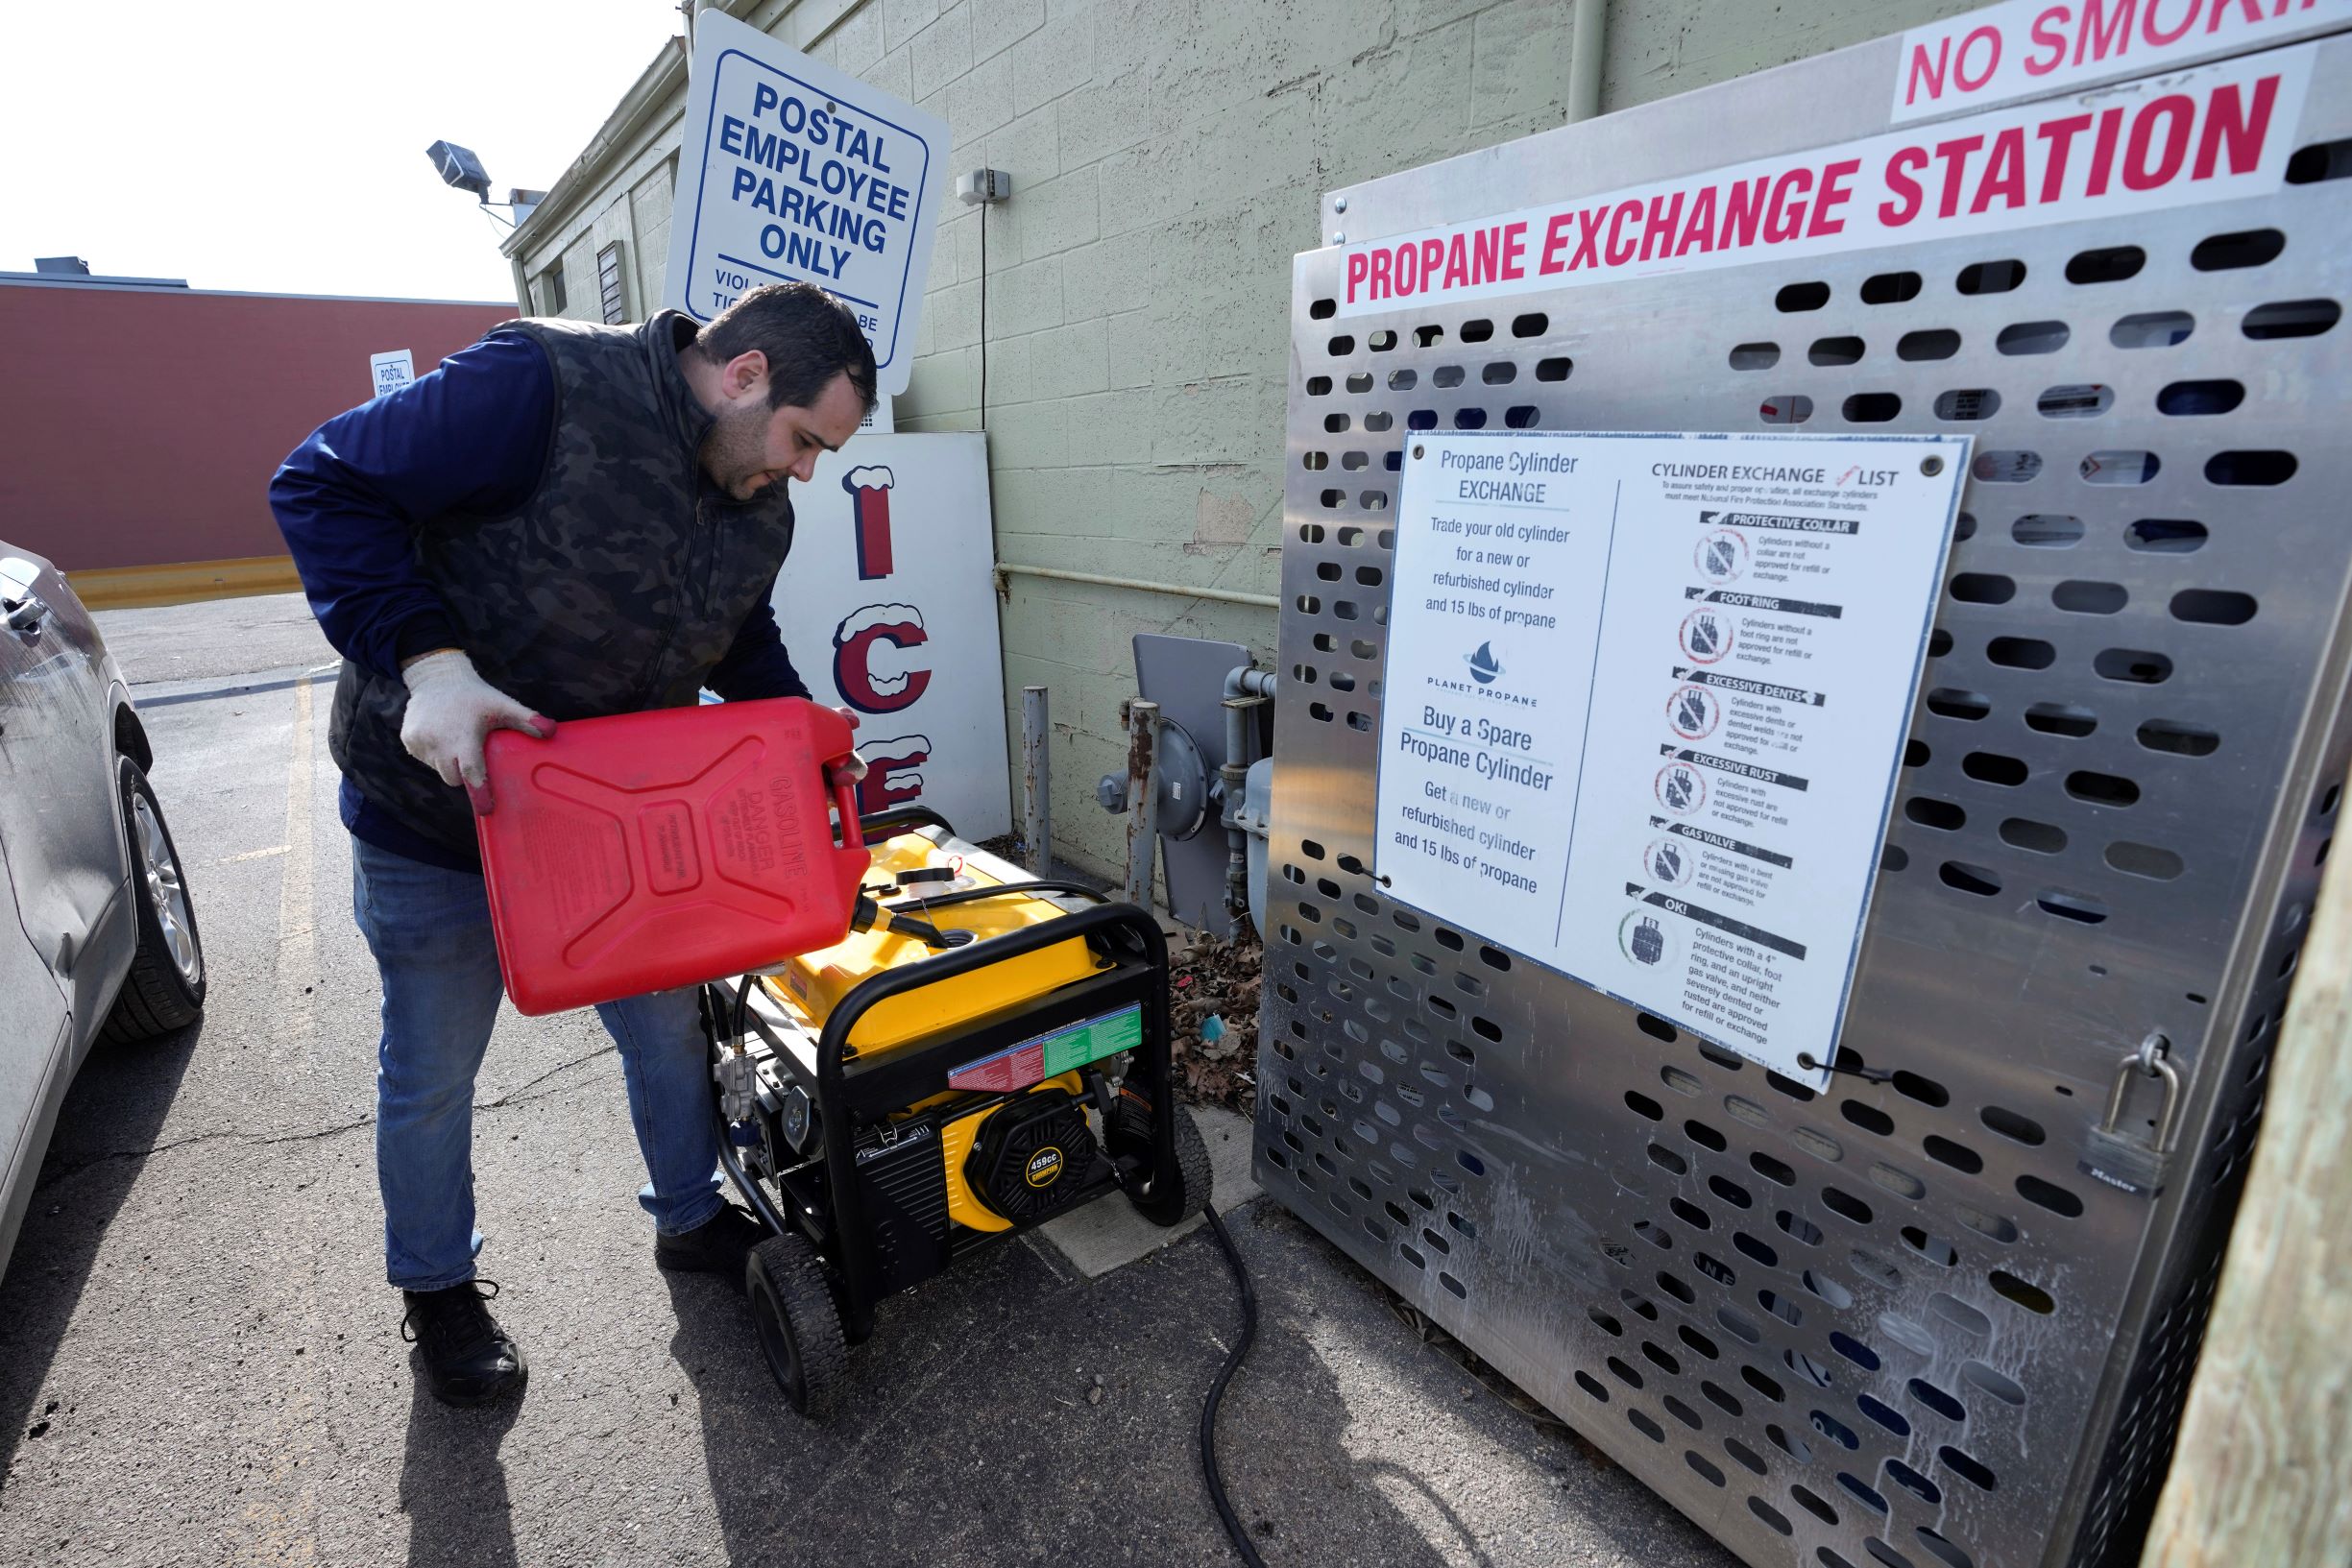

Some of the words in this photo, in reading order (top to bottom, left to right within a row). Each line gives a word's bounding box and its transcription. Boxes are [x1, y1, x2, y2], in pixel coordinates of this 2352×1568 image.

[1905, 26, 2002, 106] NO
[753, 83, 890, 174] POSTAL
[720, 114, 909, 221] EMPLOYEE
[1346, 222, 1527, 304] PROPANE
[1539, 157, 1861, 276] EXCHANGE
[1878, 74, 2281, 228] STATION
[732, 167, 886, 253] PARKING
[761, 224, 852, 279] ONLY
[859, 315, 878, 331] BE
[381, 368, 404, 381] POSTAL
[1442, 450, 1503, 472] Propane
[1510, 451, 1578, 475] Cylinder
[1652, 463, 1727, 479] CYLINDER
[1733, 466, 1825, 483] EXCHANGE
[1858, 470, 1900, 486] LIST
[1460, 480, 1546, 503] EXCHANGE
[1432, 517, 1462, 533] Trade
[1466, 523, 1492, 537] your
[1495, 522, 1514, 538] old
[1518, 525, 1570, 543] cylinder
[1733, 514, 1802, 529] PROTECTIVE
[1803, 518, 1851, 533] COLLAR
[1758, 536, 1792, 548] Cylinders
[1795, 538, 1823, 549] without
[1457, 546, 1472, 561] for
[1476, 551, 1483, 563] a
[1488, 552, 1513, 566] new
[1517, 556, 1530, 567] or
[1755, 560, 1788, 571] approved
[1433, 571, 1499, 592] refurbished
[1504, 581, 1554, 599] cylinder
[1426, 597, 1446, 612] and
[1452, 600, 1465, 614] 15
[1468, 602, 1486, 617] lbs
[1490, 606, 1501, 620] of
[1504, 609, 1556, 628] propane
[1720, 592, 1751, 606] FOOT
[1752, 595, 1780, 609] RING
[1740, 629, 1755, 639] foot
[1756, 632, 1770, 643] ring
[1785, 637, 1798, 645] not
[1742, 617, 1775, 631] Cylinders
[1777, 622, 1806, 635] without
[1737, 640, 1772, 654] approved
[1785, 648, 1803, 658] refill
[1428, 677, 1472, 693] PLANET
[1478, 688, 1537, 708] PROPANE
[1706, 674, 1763, 695] EXCESSIVE
[1764, 685, 1803, 702] DENTS
[1730, 708, 1764, 722] excessive
[1766, 715, 1785, 727] dents
[1732, 696, 1764, 712] Cylinders
[1766, 703, 1782, 713] with
[1423, 705, 1456, 736] Buy
[1461, 719, 1471, 736] a
[1477, 717, 1532, 751] Spare
[1726, 731, 1758, 745] approved
[1728, 718, 1752, 731] dented
[1401, 732, 1470, 768] Propane
[1476, 751, 1554, 791] Cylinder
[1693, 753, 1749, 776] EXCESSIVE
[1749, 764, 1779, 783] RUST
[1425, 781, 1447, 802] Get
[1463, 794, 1492, 813] new
[1495, 805, 1512, 821] or
[1715, 789, 1749, 805] excessive
[1751, 796, 1764, 808] rust
[1717, 778, 1749, 793] Cylinders
[1751, 786, 1766, 797] with
[1713, 799, 1725, 808] not
[1727, 803, 1758, 817] approved
[1771, 814, 1788, 826] refill
[748, 790, 775, 872] DANGER
[770, 776, 808, 879] GASOLINE
[1402, 804, 1474, 841] refurbished
[1479, 831, 1536, 861] cylinder
[1682, 825, 1703, 840] GAS
[1704, 832, 1736, 850] VALVE
[1394, 830, 1417, 850] and
[1422, 838, 1437, 856] 15
[1441, 843, 1460, 865] lbs
[1464, 855, 1477, 868] of
[1480, 861, 1538, 894] propane
[1702, 851, 1733, 868] Cylinders
[1734, 859, 1749, 872] with
[1697, 880, 1711, 891] refill
[1665, 899, 1687, 915] OK!
[1695, 928, 1734, 950] Cylinders
[1736, 943, 1756, 957] with
[1690, 953, 1709, 968] ring,
[1710, 961, 1727, 974] and
[1729, 968, 1740, 978] an
[1742, 973, 1774, 992] upright
[1693, 941, 1735, 964] protective
[1736, 957, 1762, 976] collar,
[1764, 968, 1782, 982] foot
[1686, 977, 1720, 1000] severely
[1722, 990, 1753, 1010] dented
[1754, 1004, 1763, 1016] or
[1688, 966, 1704, 978] gas
[1706, 971, 1730, 988] valve,
[1731, 979, 1747, 996] and
[1749, 989, 1782, 1010] neither
[1682, 1001, 1694, 1012] for
[1695, 1005, 1714, 1021] refill
[1715, 1015, 1724, 1025] or
[1727, 1020, 1768, 1045] exchange
[1684, 989, 1710, 1006] rusted
[1712, 1002, 1726, 1013] are
[1728, 1006, 1768, 1031] approved
[1031, 1154, 1056, 1170] 459cc
